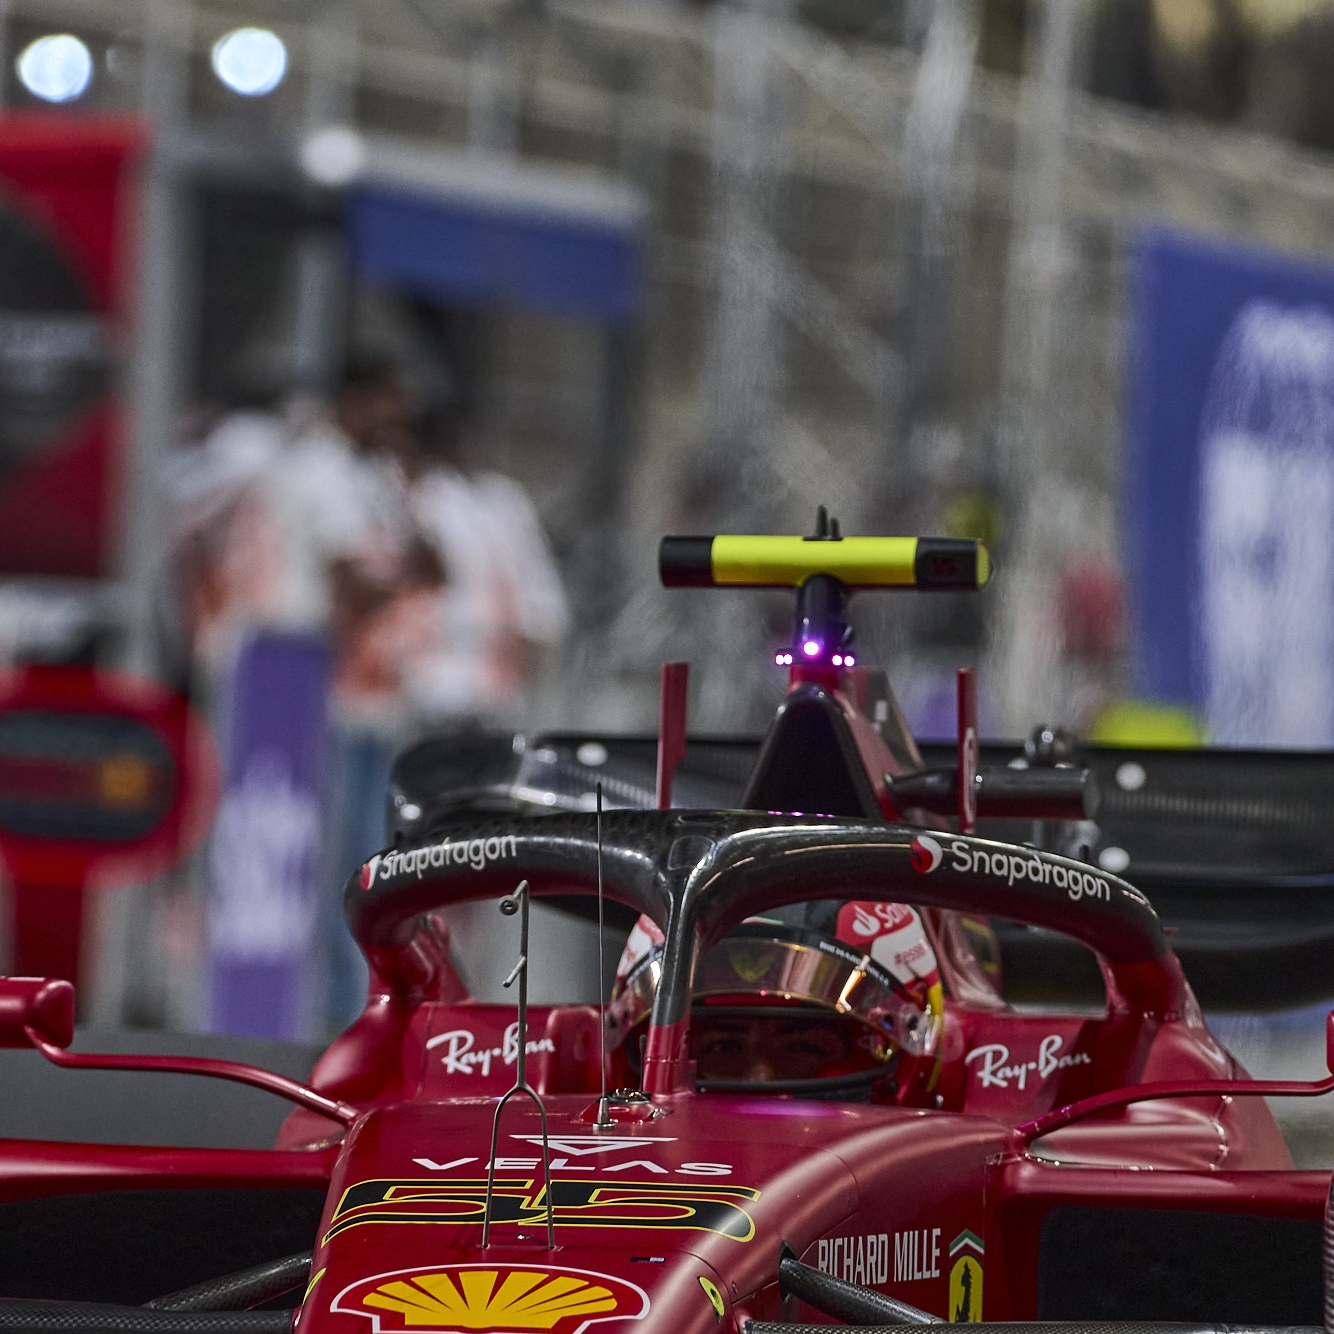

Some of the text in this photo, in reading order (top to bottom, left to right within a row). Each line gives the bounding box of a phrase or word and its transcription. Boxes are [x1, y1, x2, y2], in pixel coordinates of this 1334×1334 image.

[380, 835, 517, 880] Snapdragon
[951, 841, 1110, 901] Snapdragon
[965, 1034, 1092, 1090] Ray-Ban
[321, 1179, 763, 1248] 55
[818, 1227, 941, 1286] RICHARD MILLE
